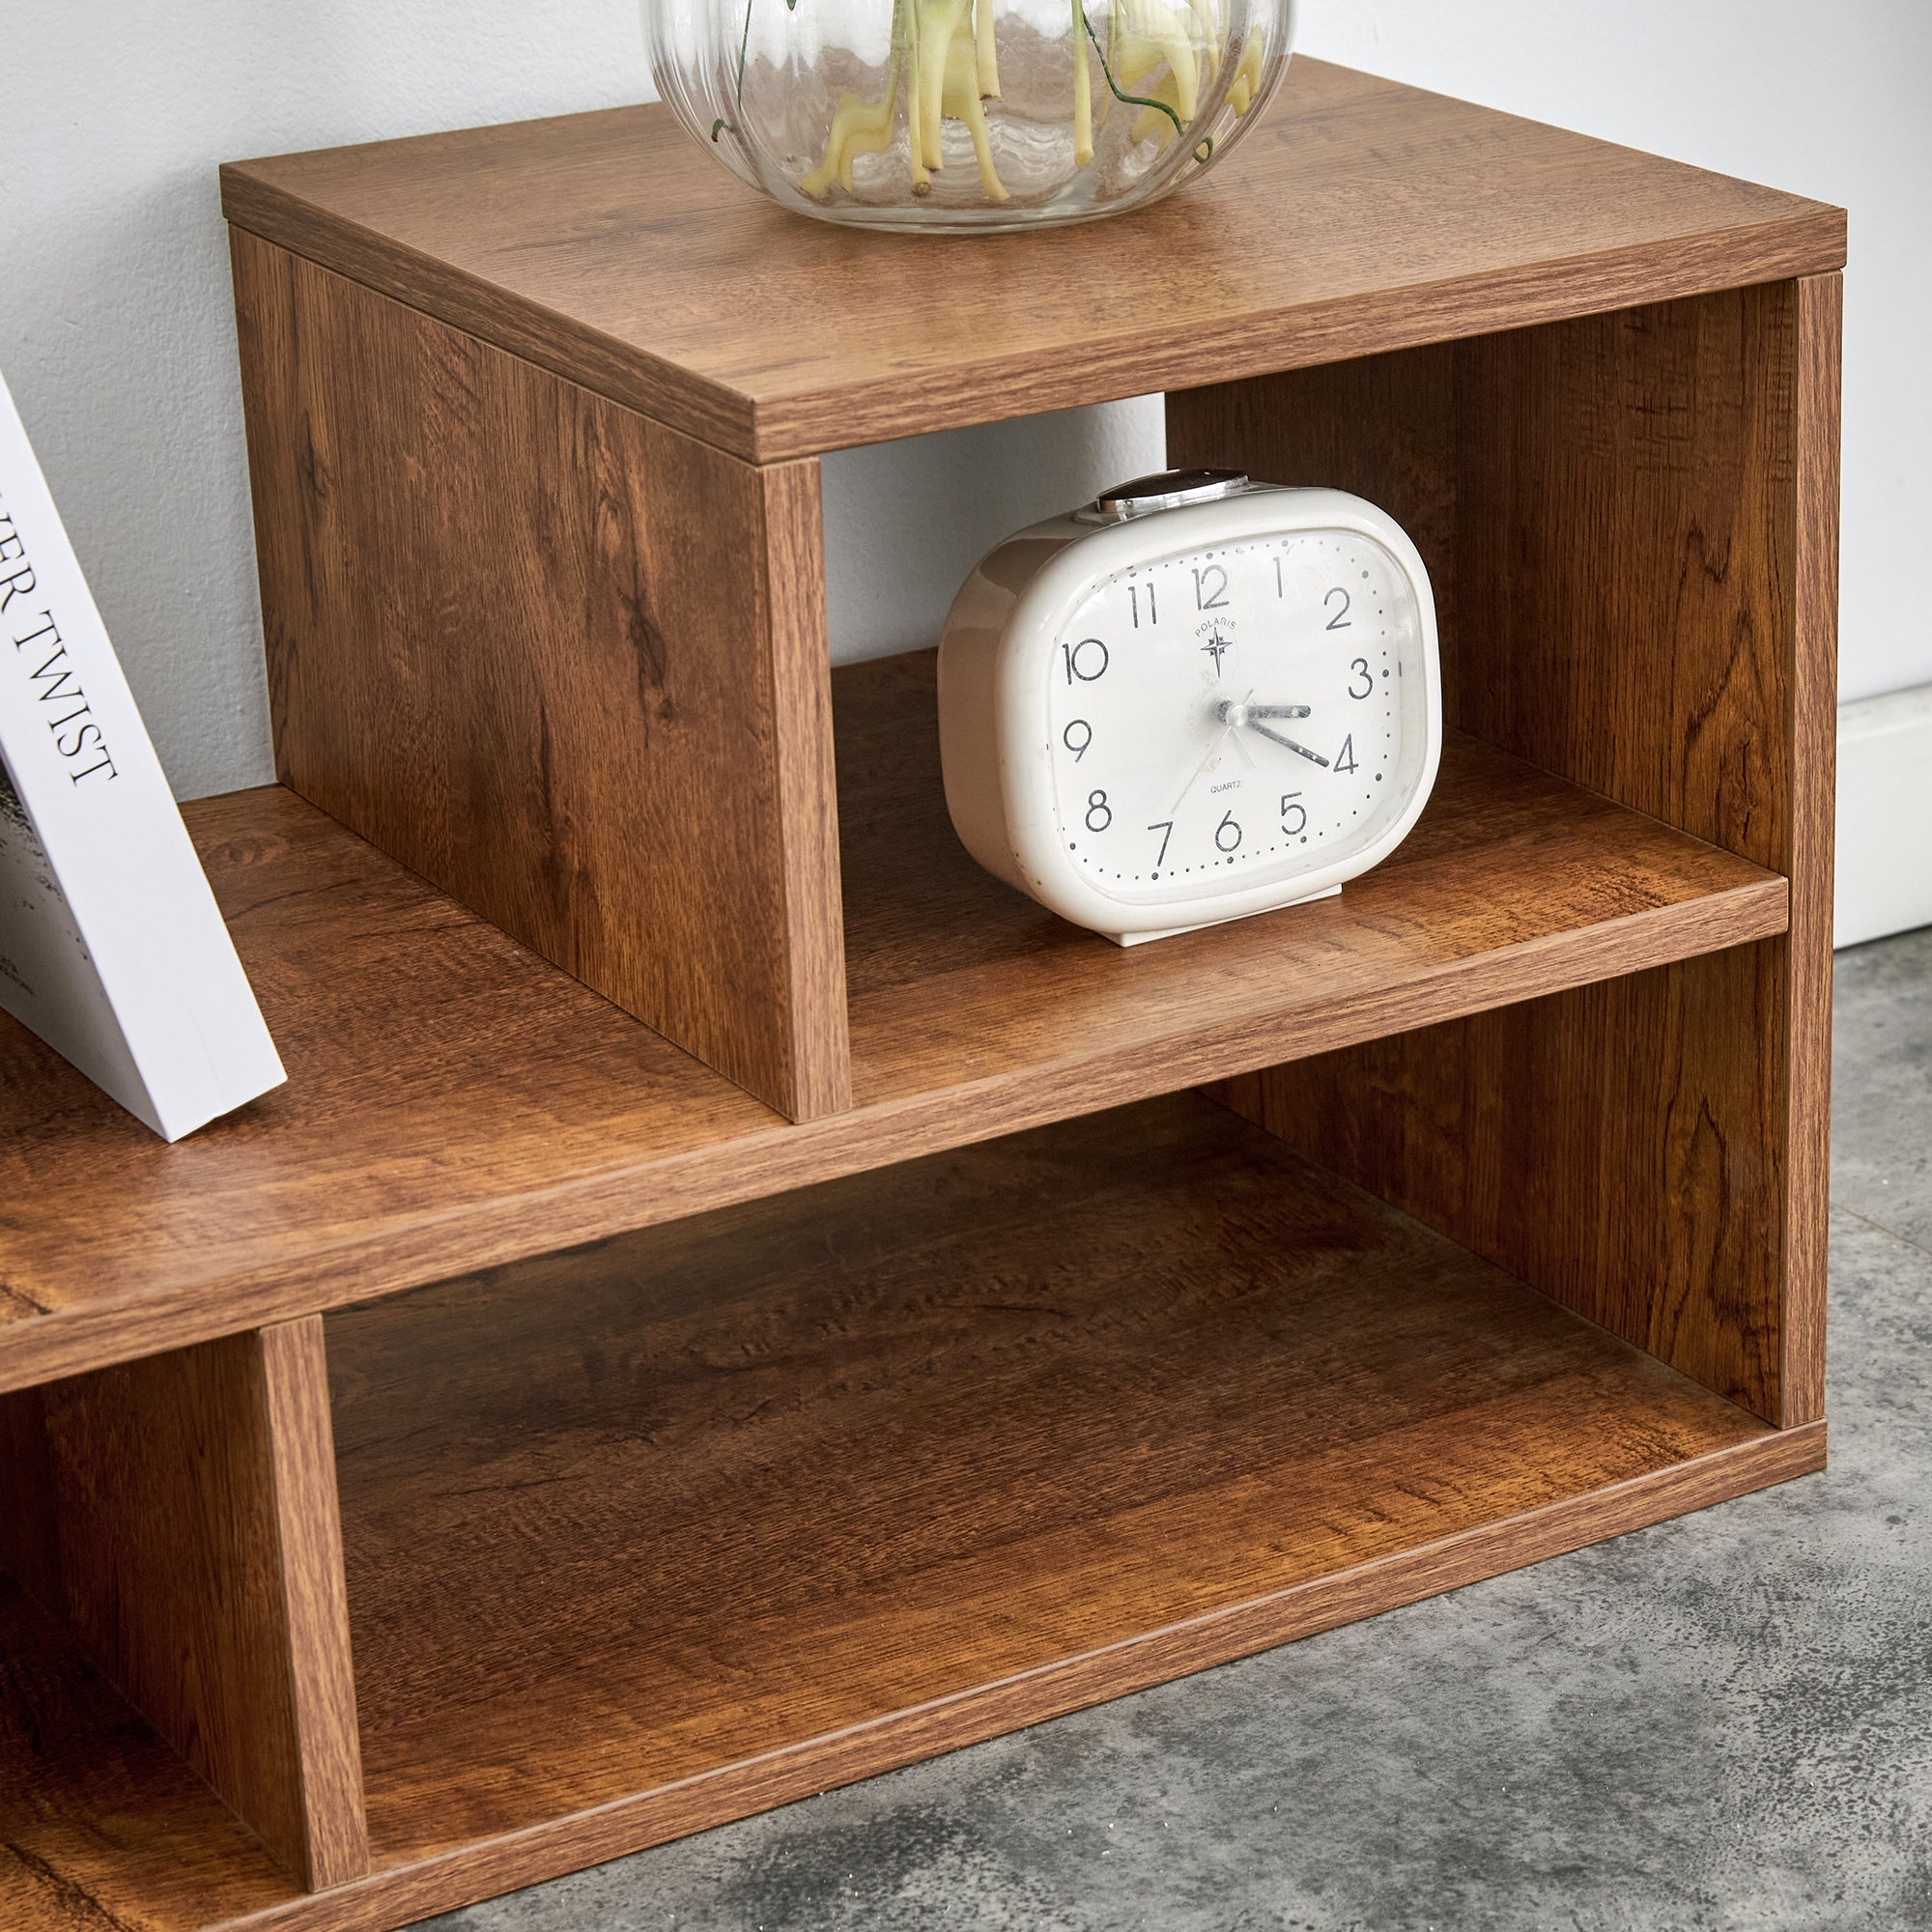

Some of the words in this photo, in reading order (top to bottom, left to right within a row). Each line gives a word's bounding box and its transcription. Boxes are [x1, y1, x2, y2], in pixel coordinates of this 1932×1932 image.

[0, 492, 37, 614] ER
[1192, 564, 1230, 611] 12
[1273, 556, 1283, 598] 1
[1128, 582, 1156, 628] 11
[1323, 587, 1351, 631] 2
[1195, 617, 1236, 638] POLARIS
[1062, 639, 1109, 685] 10
[1349, 658, 1373, 699] 3
[14, 610, 119, 786] TWIST
[1064, 720, 1092, 763] 9
[1333, 733, 1359, 775] 4
[1210, 780, 1241, 793] QUARTZ
[1085, 789, 1112, 833] 8
[1215, 810, 1242, 852] 6
[1281, 792, 1307, 836] 5
[1148, 821, 1173, 867] 7
